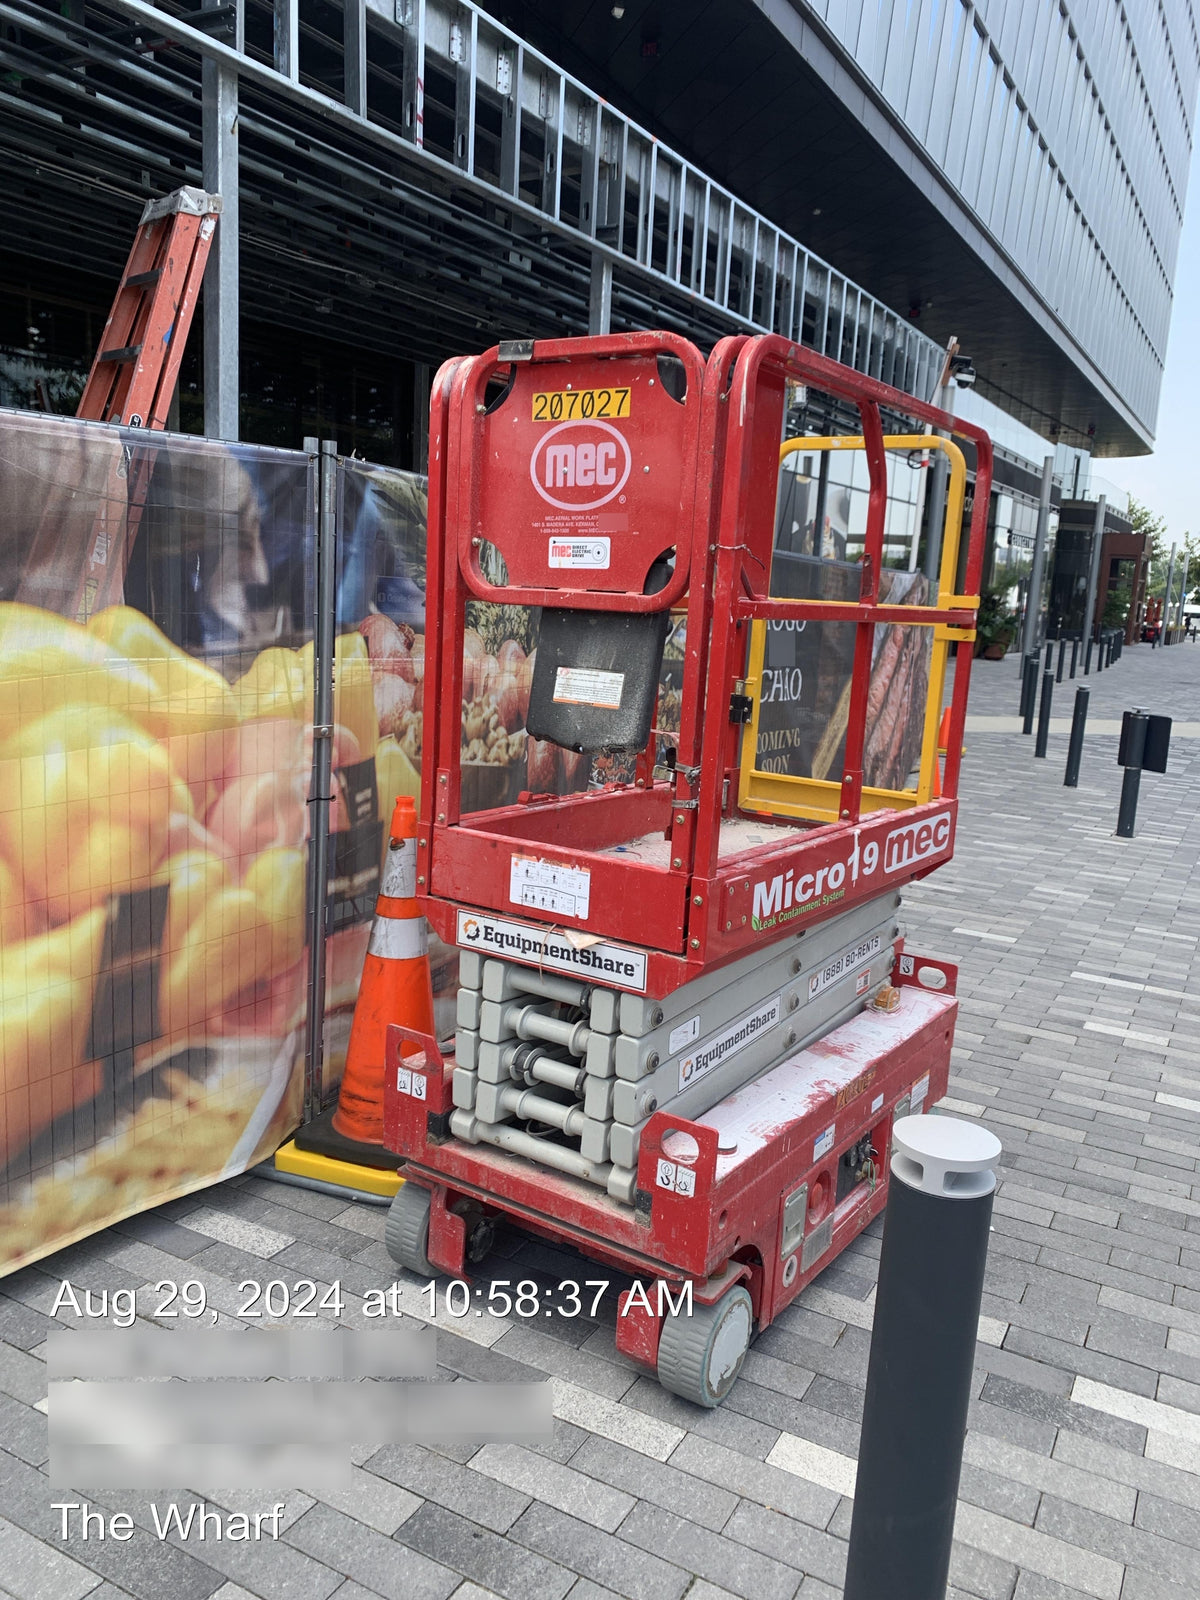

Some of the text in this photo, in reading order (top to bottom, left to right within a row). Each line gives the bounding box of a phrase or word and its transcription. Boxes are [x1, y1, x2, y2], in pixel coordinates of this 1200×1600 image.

[534, 389, 629, 420] 207027
[759, 889, 845, 931] Leak Containment System
[483, 925, 635, 977] EquipmentShare
[822, 958, 844, 984] (888)
[695, 1007, 776, 1072] EquipmentShare
